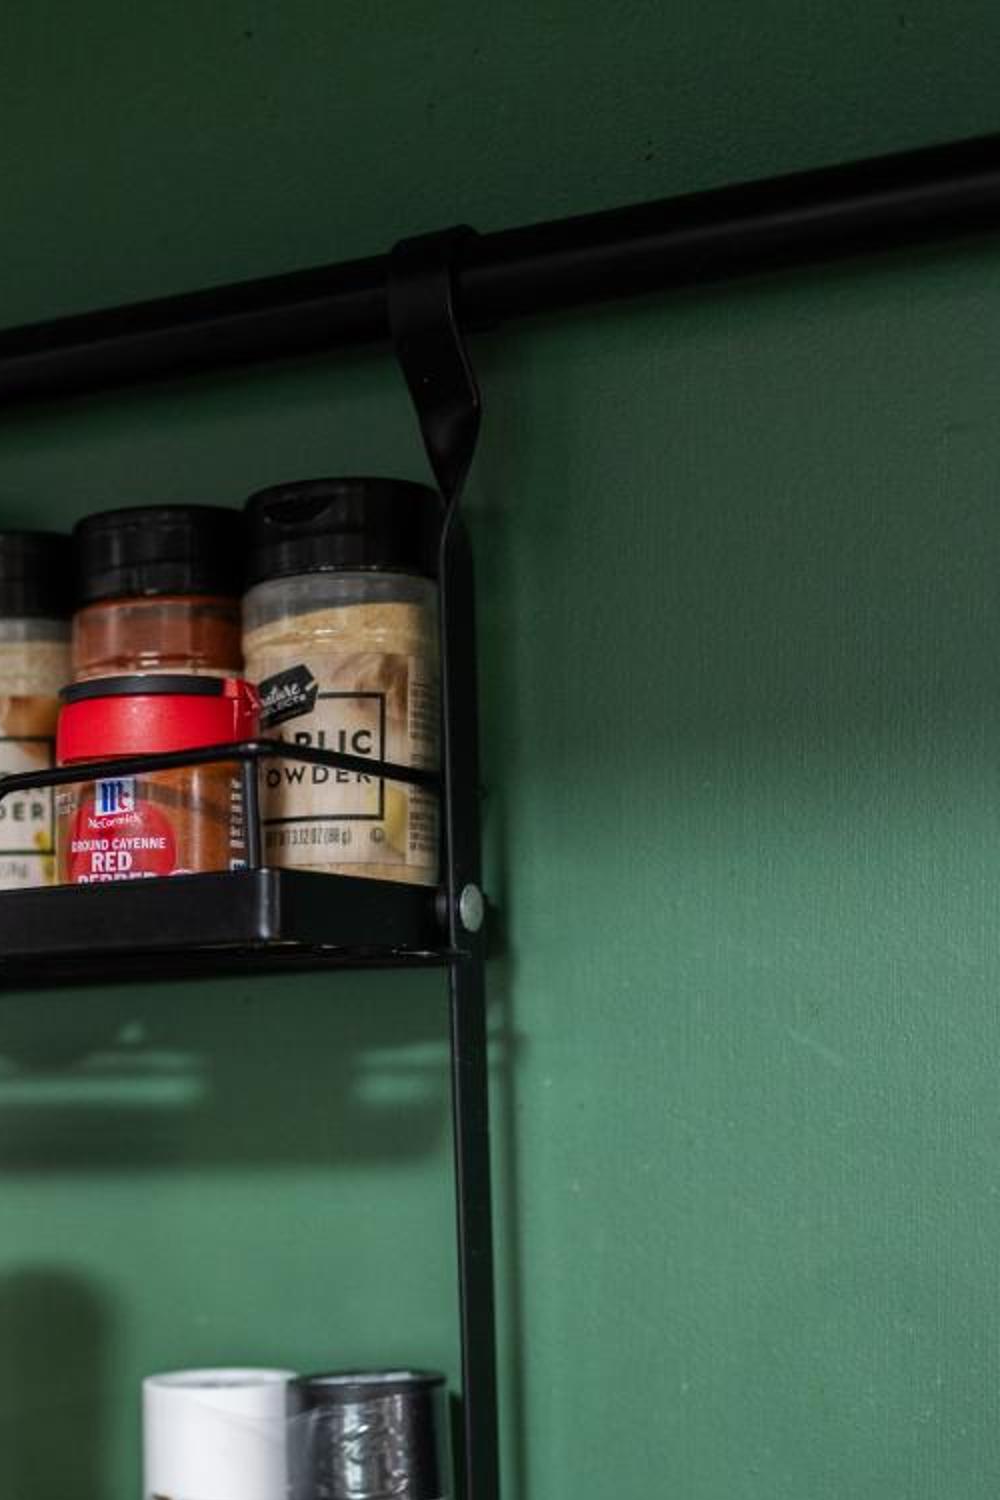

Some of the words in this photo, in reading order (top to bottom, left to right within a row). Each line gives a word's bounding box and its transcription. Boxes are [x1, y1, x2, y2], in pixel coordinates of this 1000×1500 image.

[266, 766, 371, 788] OWDER
[88, 814, 142, 829] McCormick
[72, 838, 107, 853] GROUND
[112, 837, 167, 851] CAYENNE
[91, 851, 133, 873] RED
